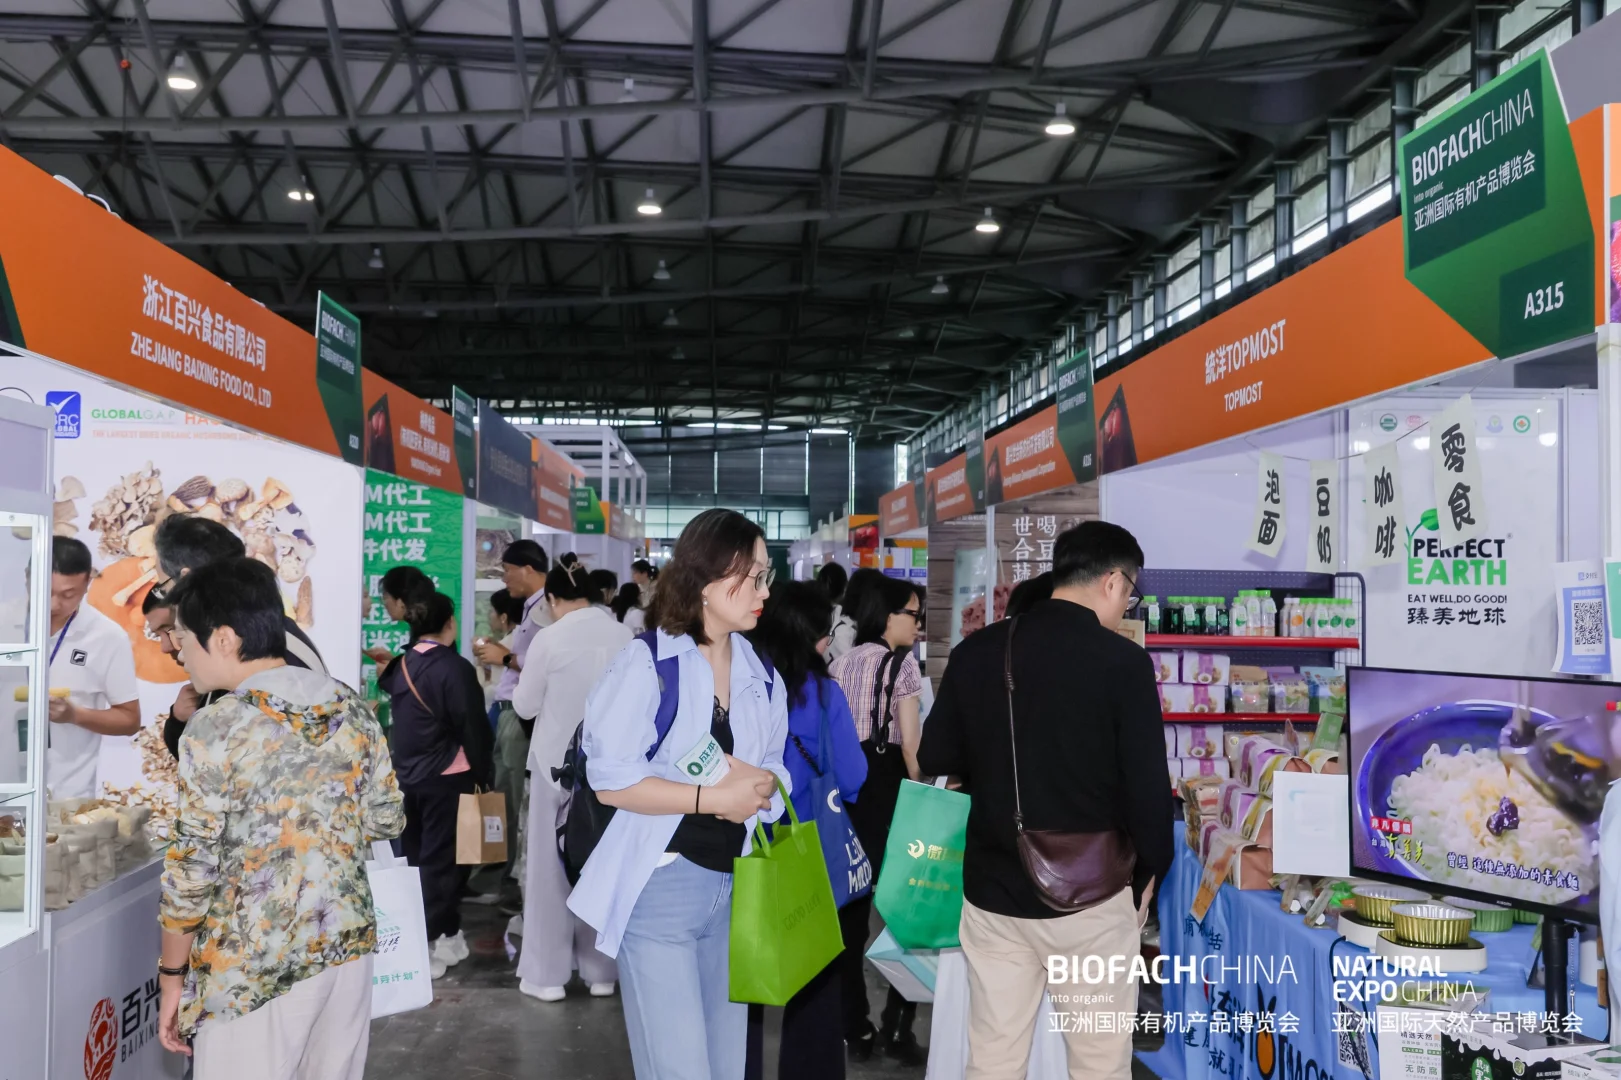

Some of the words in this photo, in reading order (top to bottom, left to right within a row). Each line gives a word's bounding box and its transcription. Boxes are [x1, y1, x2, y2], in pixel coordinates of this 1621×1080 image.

[1411, 88, 1535, 187] BIOFACHCHINA
[1414, 149, 1536, 231] 亚洲国际有机产品博览会
[143, 274, 267, 371] 浙江百兴食品有限公司
[1524, 281, 1564, 319] A315
[131, 331, 182, 373] ZHEJIANG
[184, 354, 218, 388] BAIXING
[220, 369, 242, 396] FOOD
[258, 387, 271, 409] LTD
[1224, 381, 1263, 412] TOPMOST
[1258, 469, 1280, 545] 泡面
[1375, 466, 1397, 558] 咖啡
[1441, 423, 1476, 531] 零食
[1316, 478, 1331, 564] 豆奶
[1407, 558, 1507, 585] EARTH
[1408, 594, 1426, 603] EAT
[1474, 594, 1507, 604] GOOD!
[1407, 607, 1507, 626] 臻美地球
